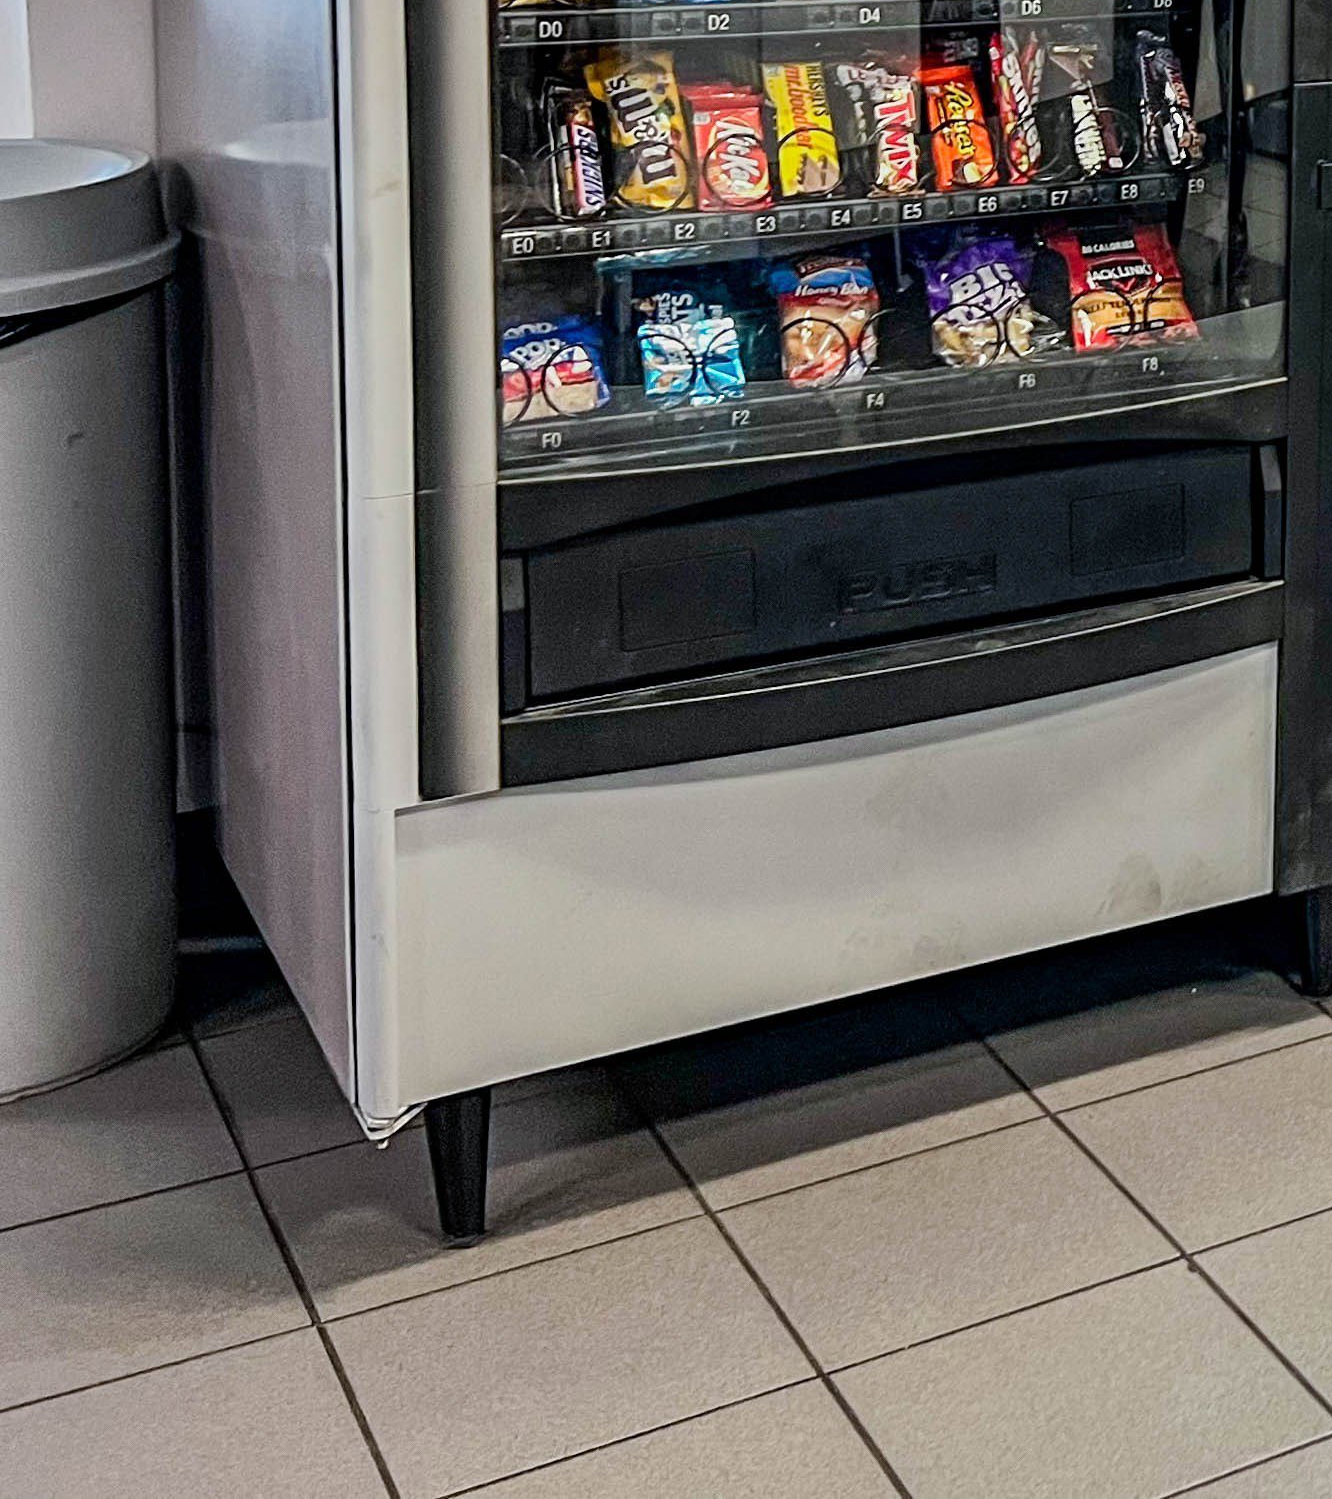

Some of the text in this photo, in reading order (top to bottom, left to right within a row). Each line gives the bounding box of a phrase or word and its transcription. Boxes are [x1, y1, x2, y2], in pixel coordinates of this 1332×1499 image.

[859, 8, 880, 24] D4
[1021, 0, 1041, 16] D6
[539, 22, 562, 38] D0
[708, 15, 730, 31] D2
[875, 92, 916, 183] TWIX
[576, 129, 606, 210] SNICKERS
[1051, 190, 1069, 206] E7
[1121, 184, 1139, 199] E8
[903, 204, 922, 220] E5
[978, 196, 998, 212] E6
[756, 217, 776, 233] E3
[831, 211, 851, 227] E4
[592, 231, 611, 247] E1
[675, 224, 695, 240] E2
[512, 237, 534, 253] E0
[1142, 358, 1158, 372] F8
[1019, 374, 1035, 389] F6
[866, 393, 884, 407] F4
[732, 410, 750, 425] F2
[542, 432, 561, 448] F0
